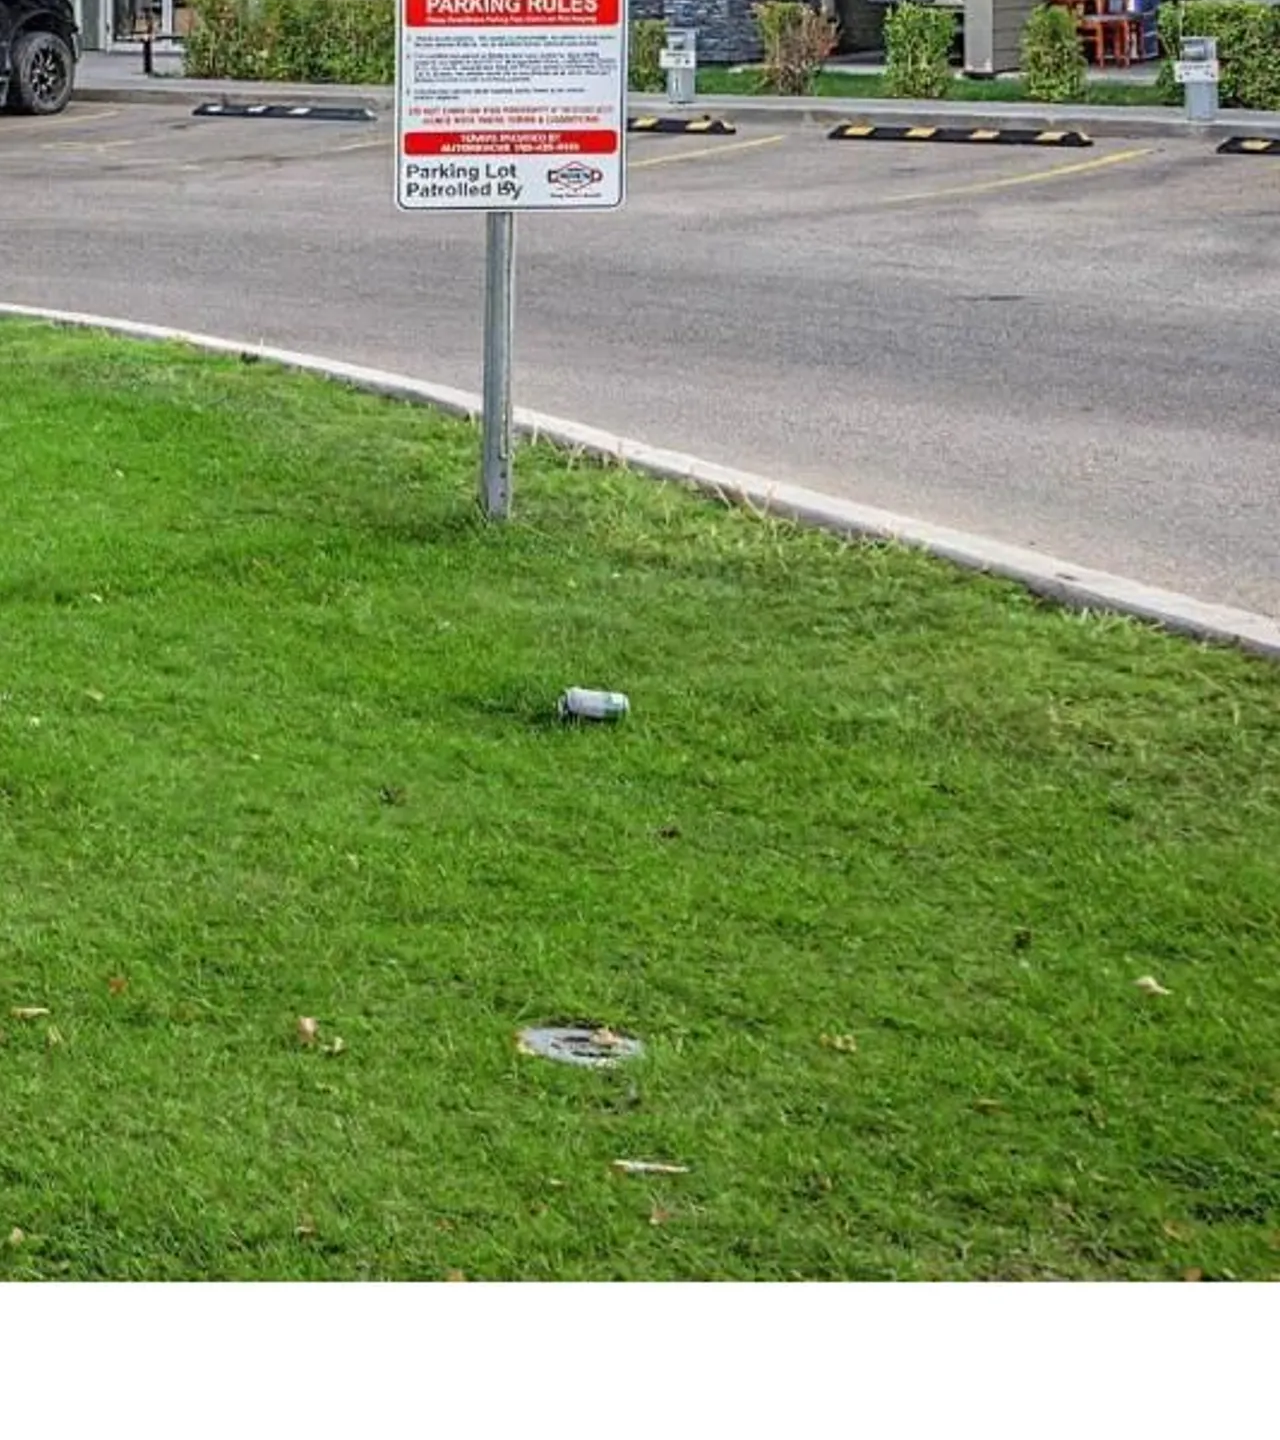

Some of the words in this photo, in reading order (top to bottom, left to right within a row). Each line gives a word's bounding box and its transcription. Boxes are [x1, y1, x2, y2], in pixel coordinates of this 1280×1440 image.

[406, 164, 479, 185] Parking
[486, 163, 517, 179] Lot
[406, 181, 493, 198] Patrolled
[497, 180, 523, 200] By
